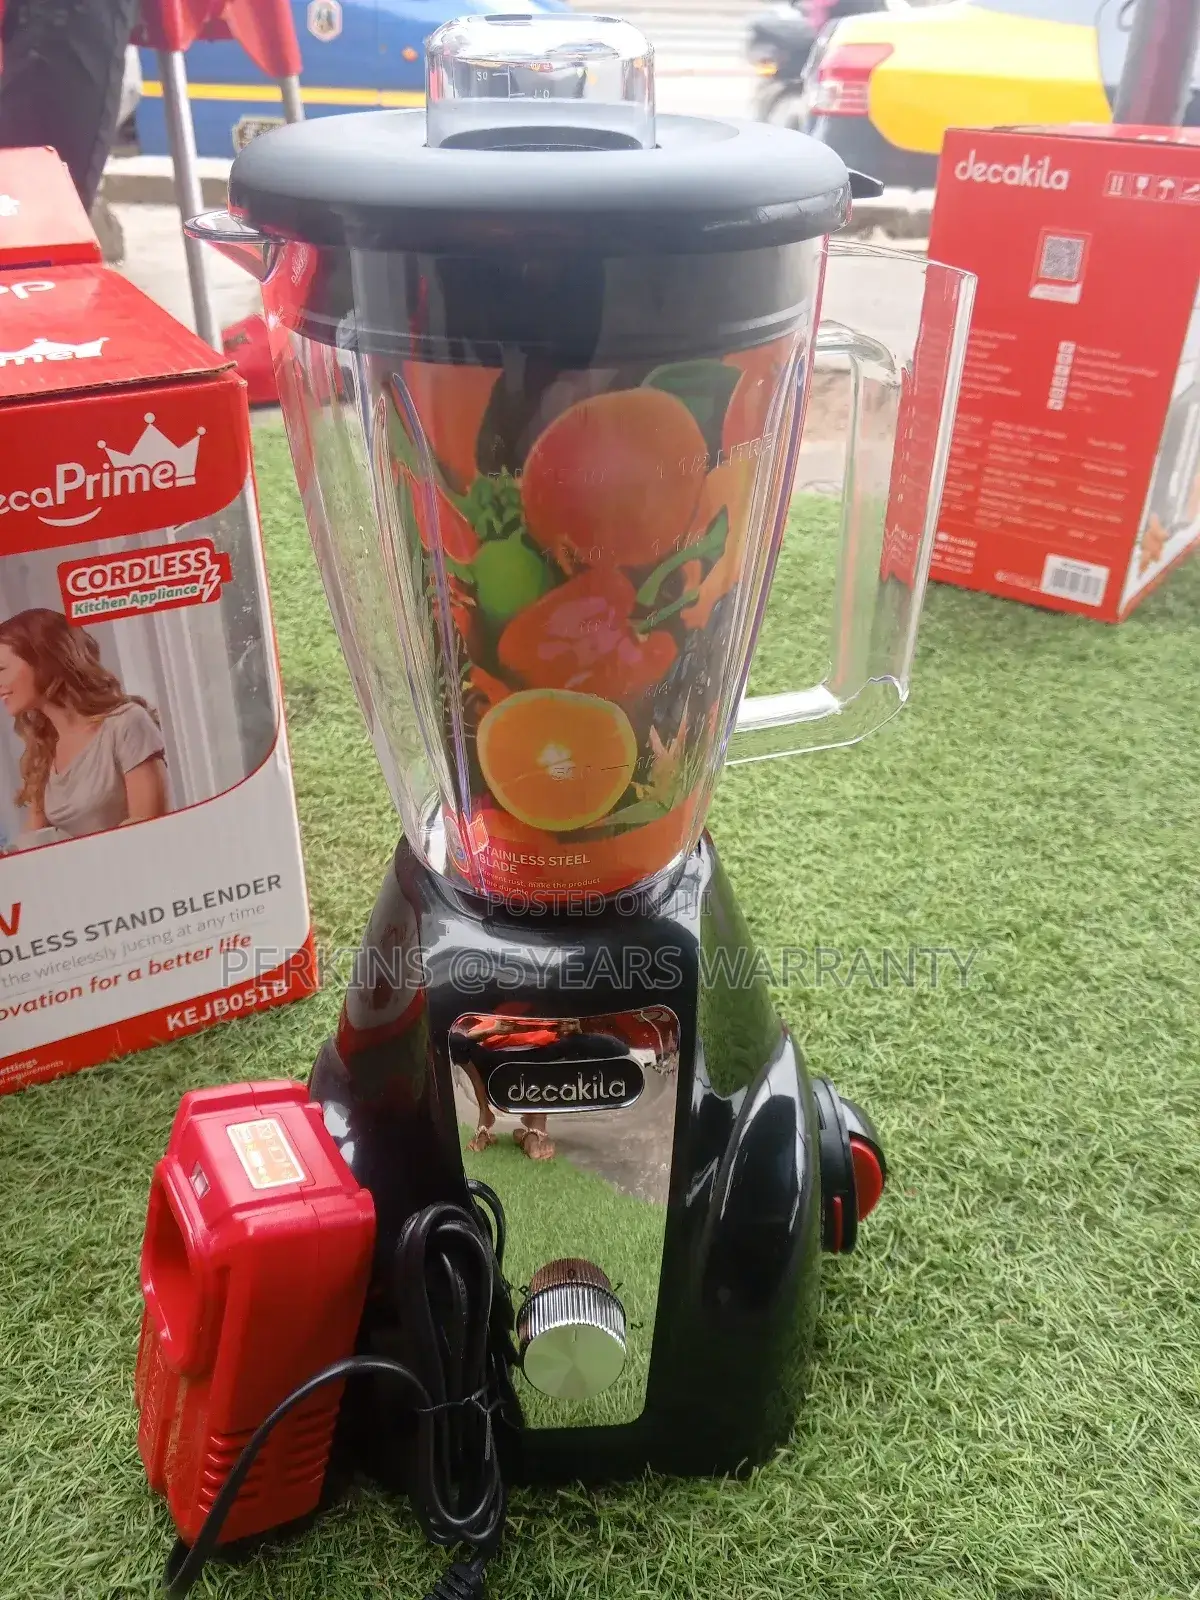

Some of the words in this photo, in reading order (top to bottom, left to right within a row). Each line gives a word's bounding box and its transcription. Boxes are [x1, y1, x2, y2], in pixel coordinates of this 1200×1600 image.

[954, 148, 1070, 191] decakila
[70, 550, 209, 595] CORDLESS
[73, 592, 128, 617] Kitchen
[130, 583, 198, 606] Appliance
[479, 854, 518, 874] BLADE
[548, 854, 590, 867] STEEL
[508, 877, 526, 889] rust,
[528, 880, 551, 889] make
[552, 880, 567, 889] the
[568, 877, 601, 889] product
[84, 906, 165, 942] STAND
[172, 874, 282, 918] BLENDER
[2, 973, 31, 988] the
[34, 947, 116, 979] wirelessly
[121, 929, 172, 957] jucing
[176, 924, 193, 938] at
[196, 915, 226, 932] any
[229, 903, 266, 923] time
[90, 973, 121, 994] for
[127, 967, 142, 982] a
[148, 945, 213, 976] better
[219, 934, 252, 954] life
[166, 979, 289, 1032] KEJB051B
[508, 1069, 627, 1102] decakila
[630, 1321, 644, 1330] 2
